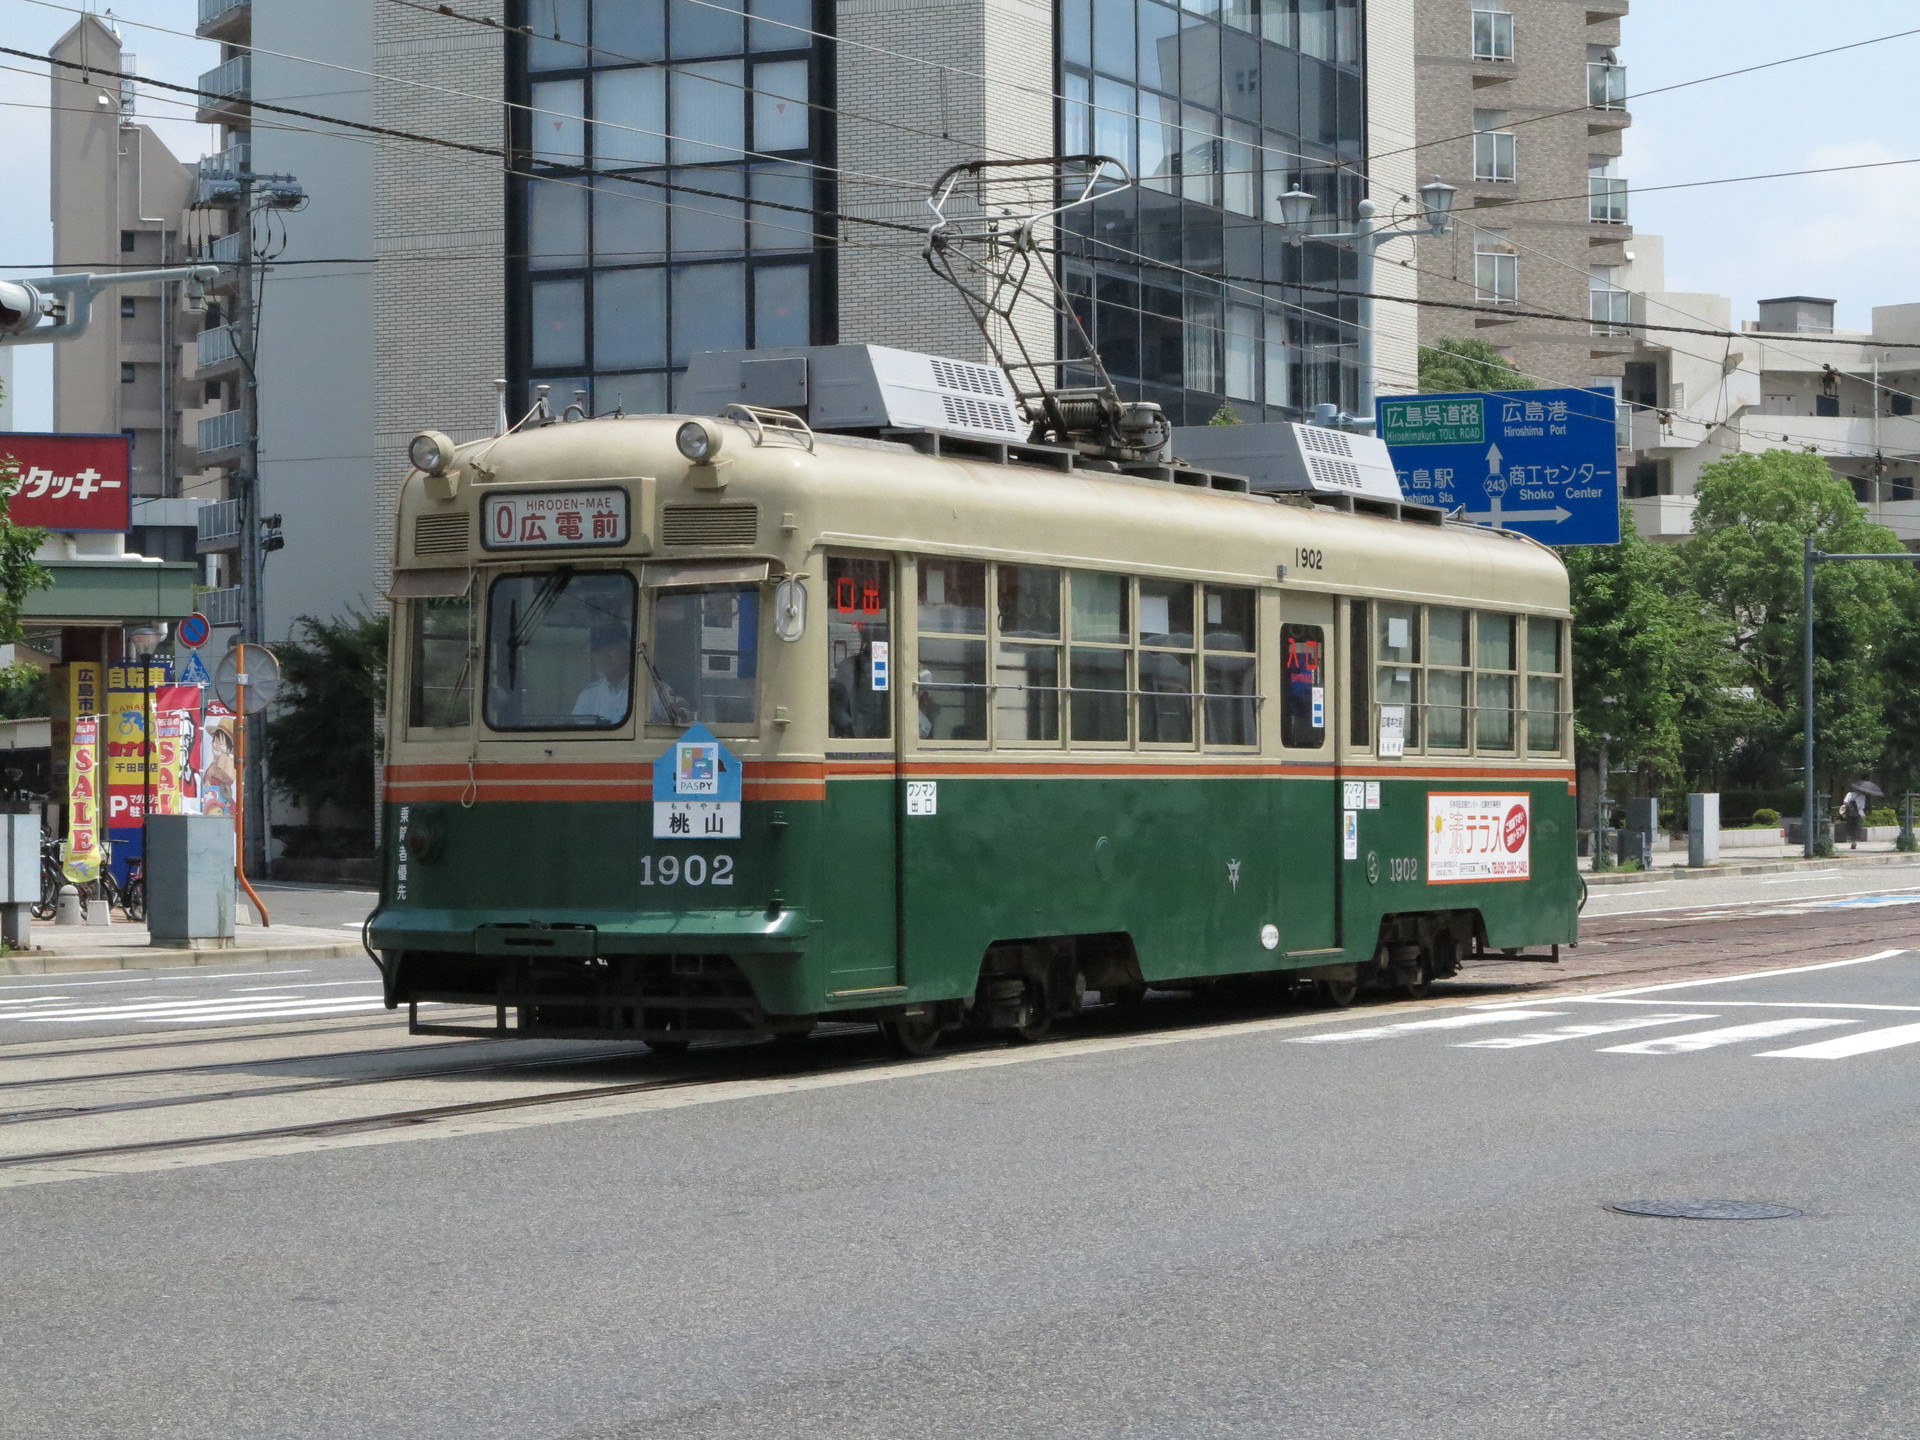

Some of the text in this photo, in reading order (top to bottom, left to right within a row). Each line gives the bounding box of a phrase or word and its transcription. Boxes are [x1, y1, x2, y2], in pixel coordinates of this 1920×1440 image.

[1386, 404, 1480, 427] 広島呉道路
[1502, 400, 1568, 423] 広島港
[1439, 428, 1457, 440] TOLL
[1460, 427, 1480, 439] ROAD
[1504, 424, 1567, 437] Hiroshima Port
[1486, 480, 1505, 492] 243
[1509, 463, 1611, 487] 商工センター
[526, 497, 611, 511] HIRODEN-MAE
[1520, 487, 1602, 501] Shoko Center
[496, 505, 513, 539] 0
[519, 510, 619, 542] 広電前
[1295, 547, 1323, 570] 1902
[1287, 637, 1319, 670] 入口
[681, 782, 712, 791] PASPY
[908, 784, 936, 797] ワンマン
[1345, 783, 1364, 794] ワンマン
[71, 748, 94, 853] SALE
[110, 796, 128, 817] P
[911, 798, 932, 813] 出口
[669, 812, 724, 834] 桃山
[640, 855, 734, 886] 1902
[1390, 858, 1418, 881] 1902
